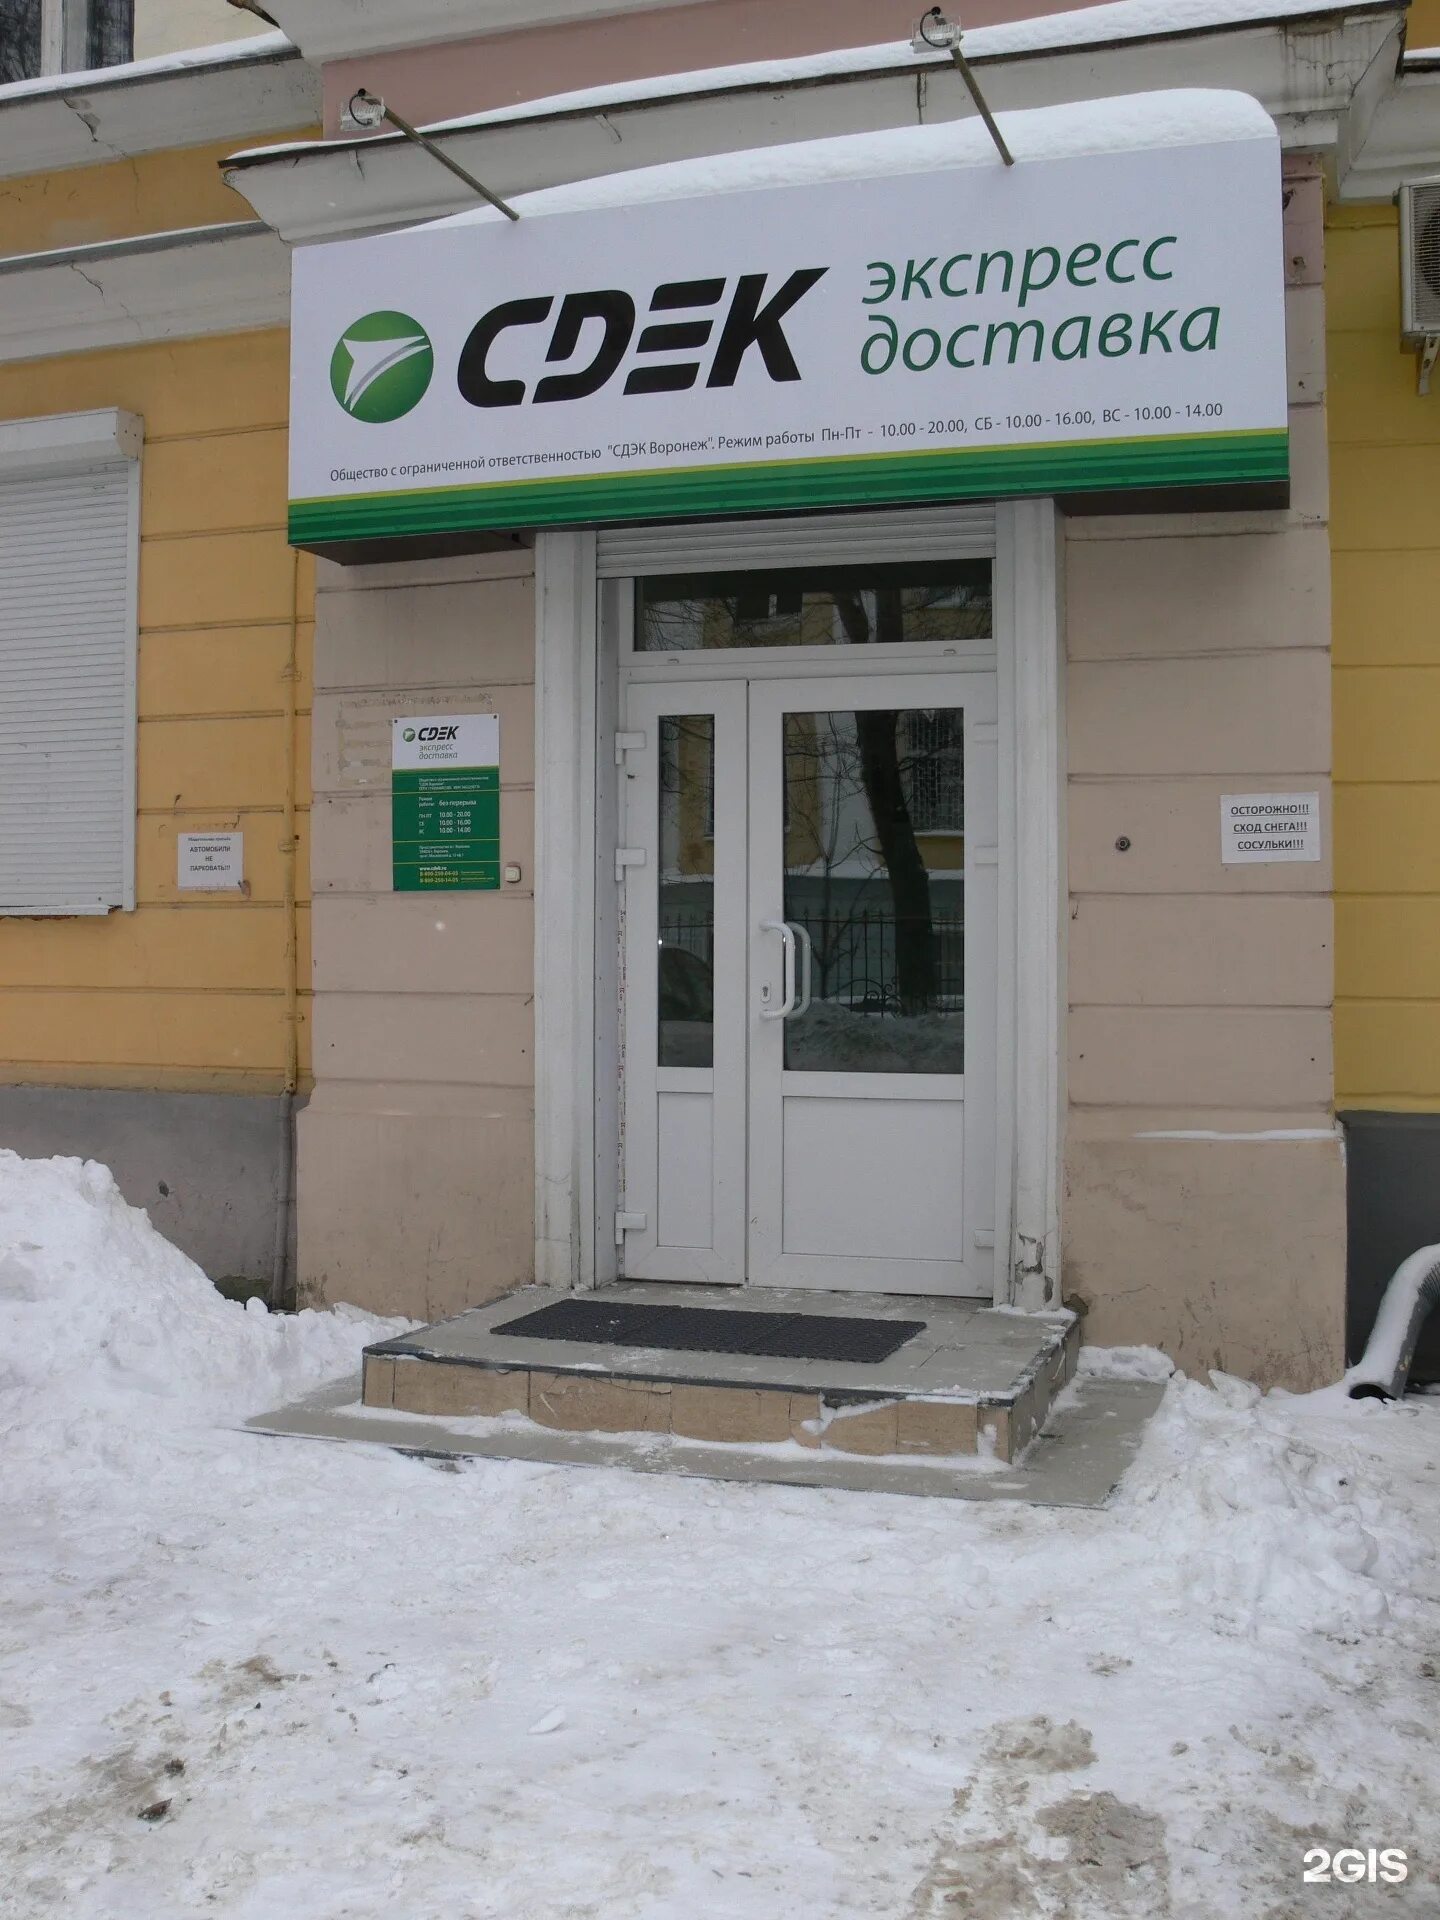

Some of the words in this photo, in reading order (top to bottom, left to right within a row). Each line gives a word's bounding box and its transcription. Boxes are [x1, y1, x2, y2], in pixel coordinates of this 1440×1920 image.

[862, 235, 1178, 306] экспресс
[457, 267, 831, 408] CDEK
[860, 304, 1221, 375] доставка
[330, 468, 388, 482] Общество
[390, 466, 397, 476] с
[399, 456, 486, 477] ограниченной
[488, 448, 601, 468] ответственностью
[607, 442, 647, 459] "СДЭК
[650, 437, 715, 456] Воронеж".
[718, 436, 762, 449] Режим
[766, 430, 815, 448] работы
[821, 426, 862, 441] Пн-Пт
[881, 423, 916, 437] 10.00
[928, 419, 968, 434] 20.00,
[974, 417, 993, 431] СБ
[1005, 414, 1042, 429] 10.00
[1055, 411, 1096, 426] 16.00,
[1103, 409, 1121, 422] ВС
[1135, 406, 1172, 420] 10.00
[1185, 403, 1223, 417] 14.00
[418, 725, 460, 741] CDEK
[419, 743, 454, 752] экспресс
[419, 752, 458, 760] доставка
[1230, 804, 1309, 816] ОСТОРОЖНО!!!
[1233, 823, 1262, 834] СХОД
[1264, 822, 1307, 832] СНЕГА!!!
[1237, 839, 1304, 850] СОСУЛЬКИ!!!
